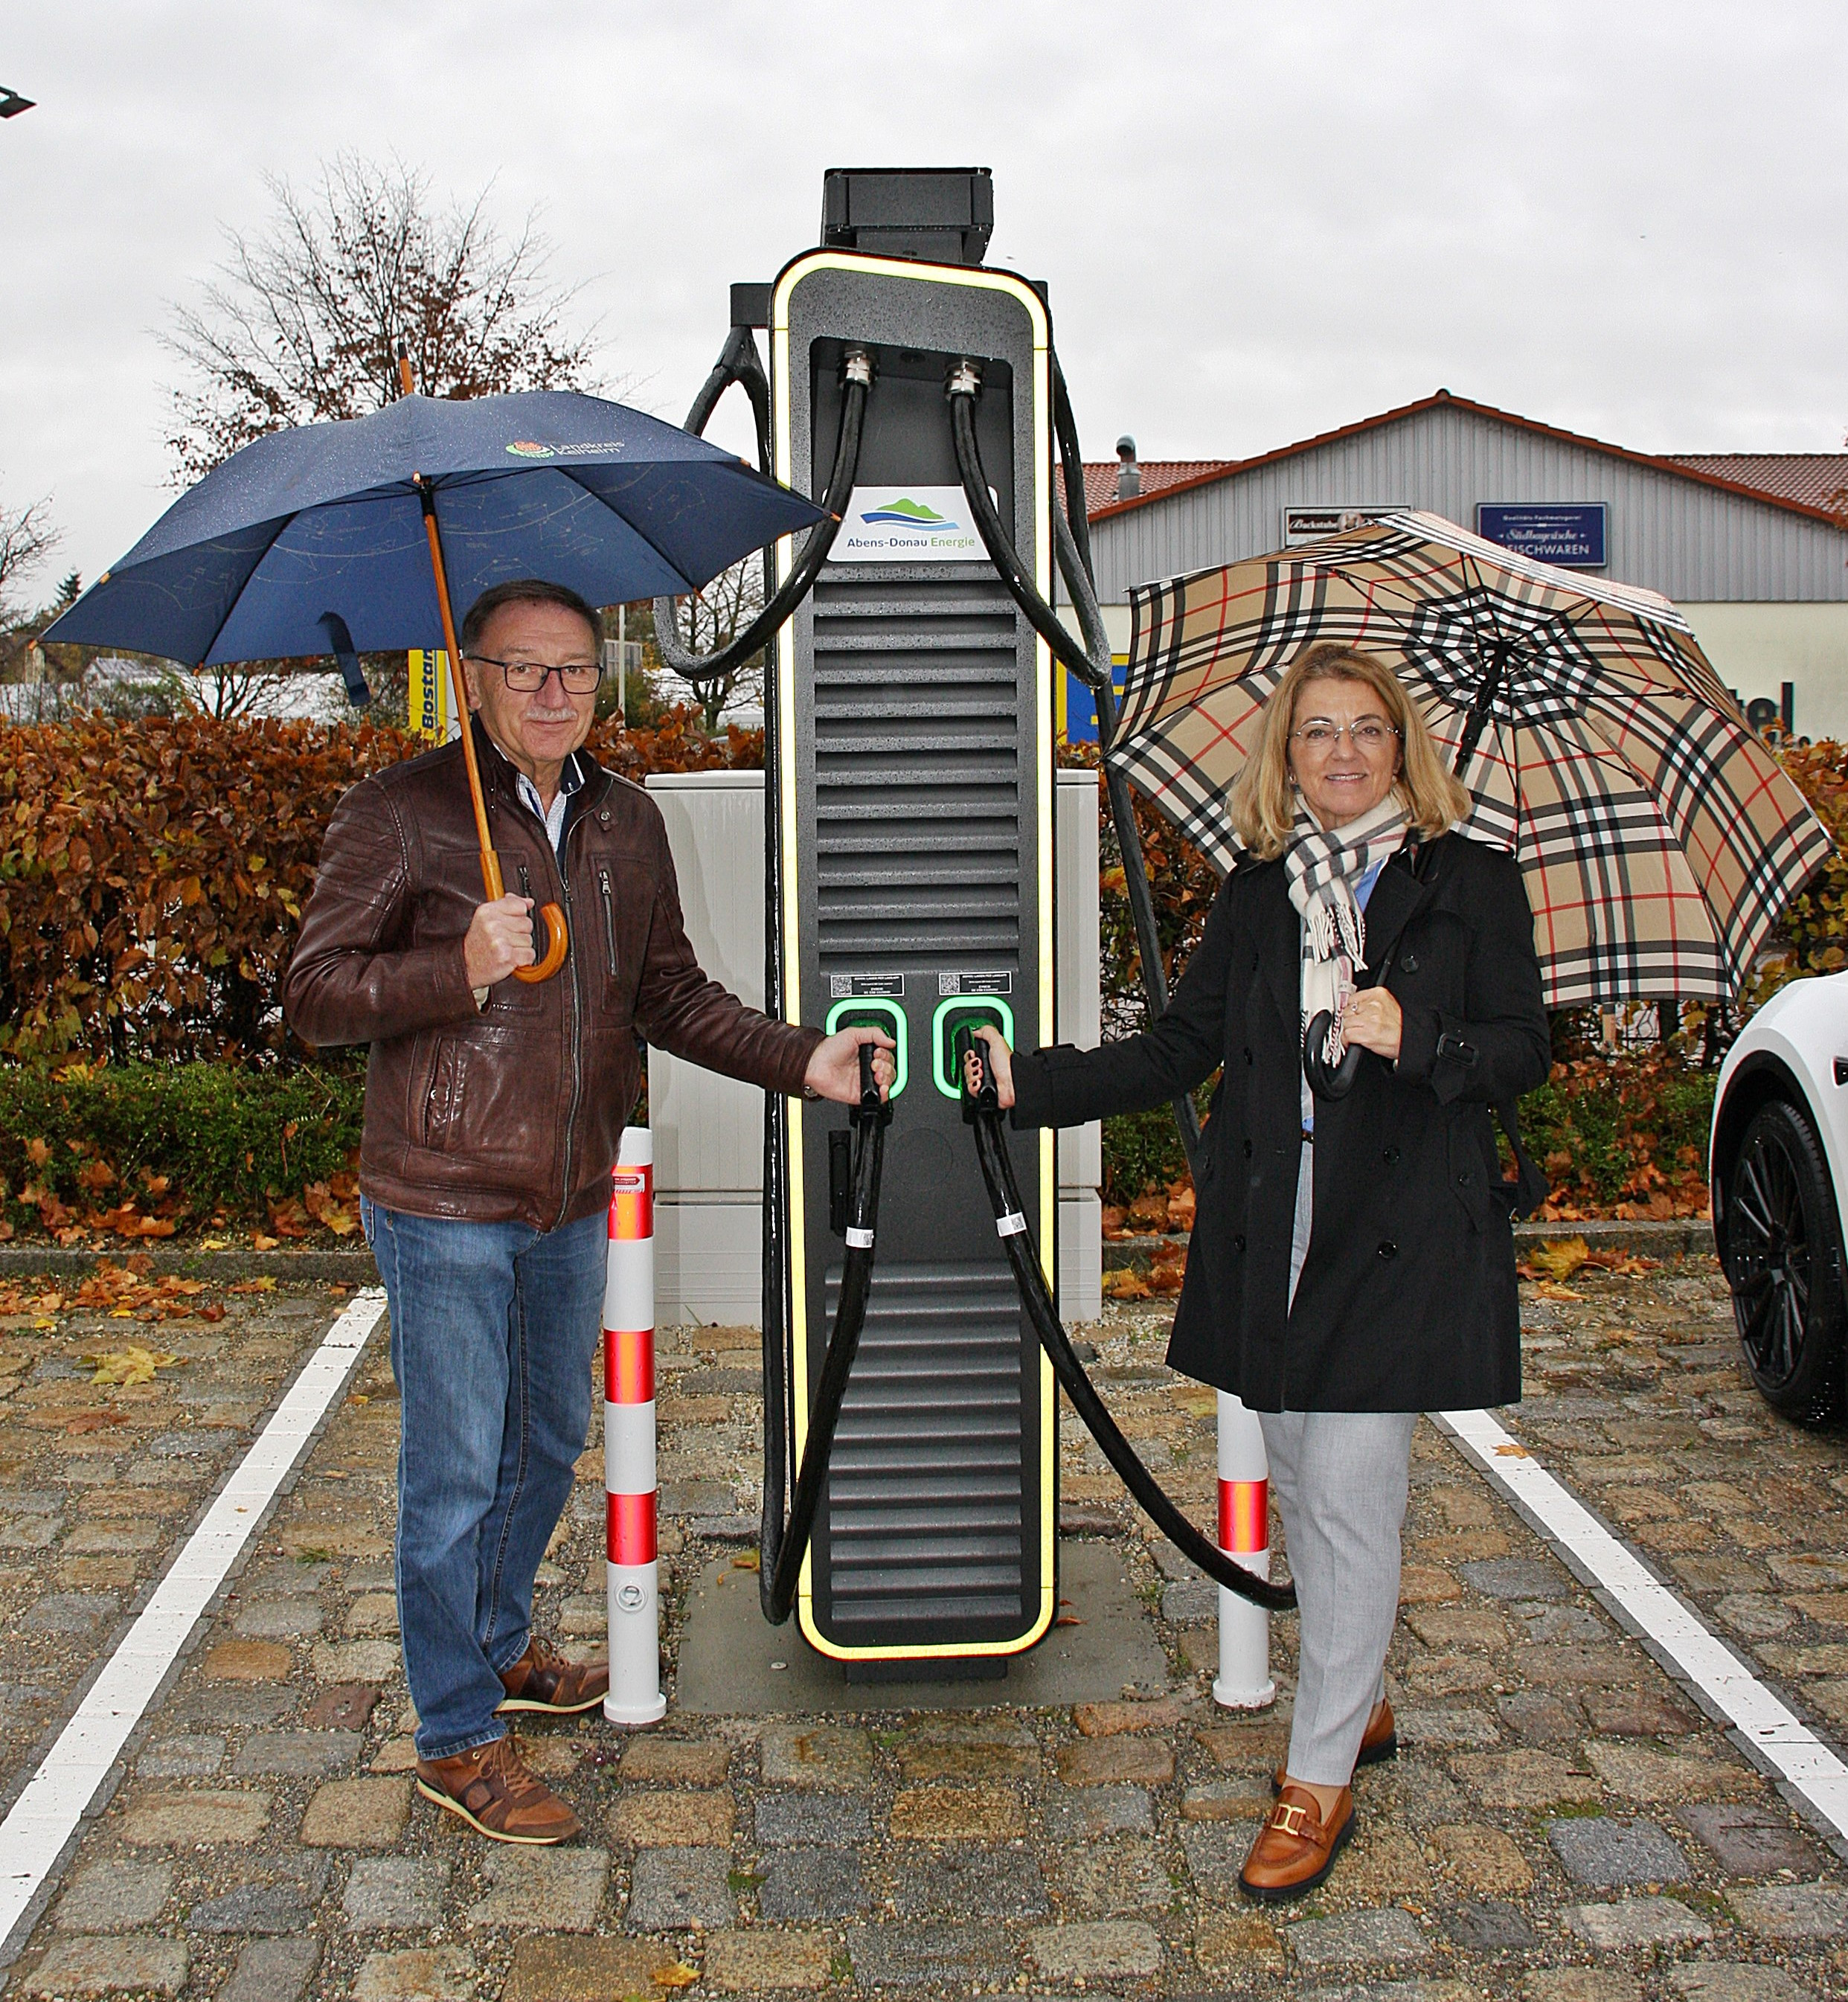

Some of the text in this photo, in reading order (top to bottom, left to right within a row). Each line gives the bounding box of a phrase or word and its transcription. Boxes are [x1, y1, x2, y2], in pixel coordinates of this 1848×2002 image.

[847, 536, 975, 548] Abens-Donau Energie
[1504, 544, 1590, 555] EISCHWAREN
